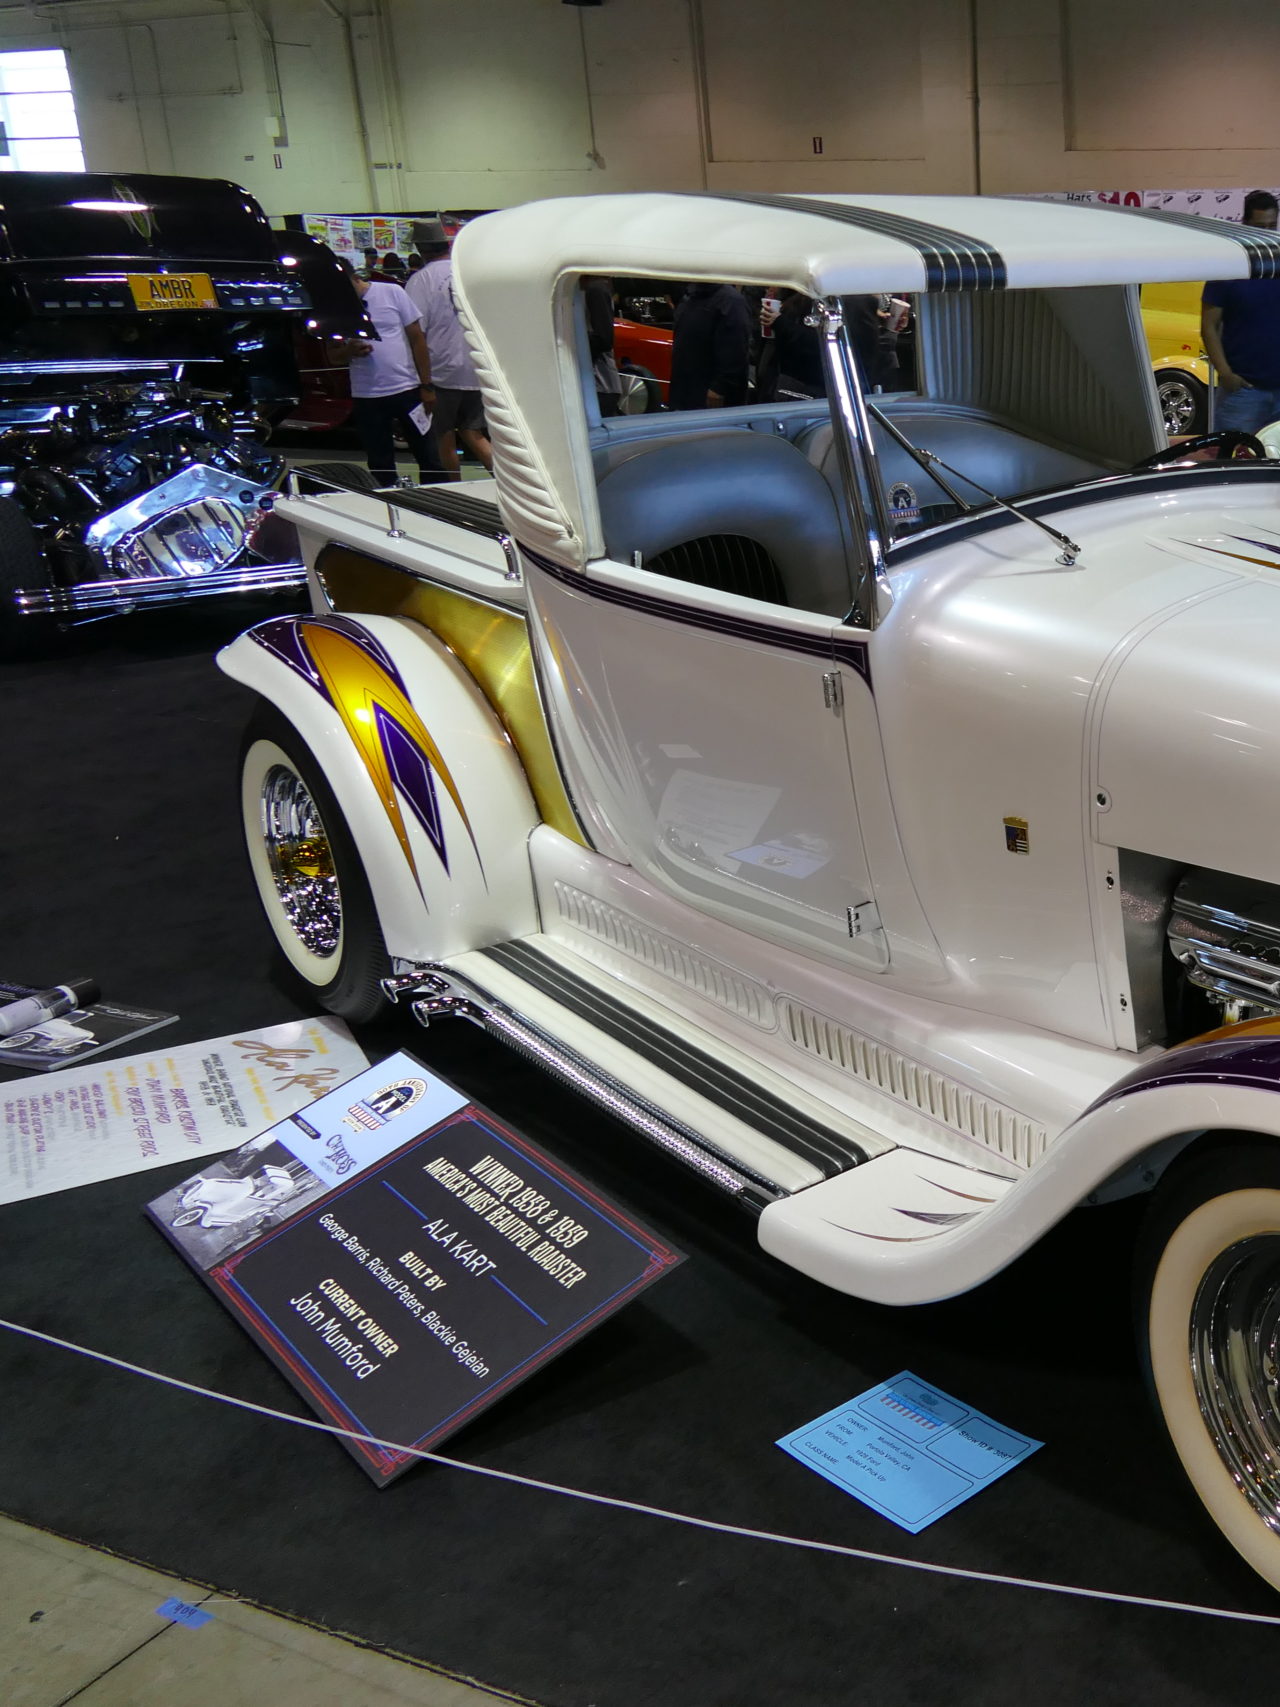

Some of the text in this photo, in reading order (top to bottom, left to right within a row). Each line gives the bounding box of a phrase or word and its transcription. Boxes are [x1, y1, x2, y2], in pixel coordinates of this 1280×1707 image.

[149, 279, 195, 299] AMBR
[155, 301, 198, 309] OREGON
[371, 1097, 397, 1115] A
[391, 1090, 407, 1103] MODEL
[468, 1154, 589, 1249] WINNER 1958 & 1959
[422, 1156, 587, 1289] AMERICA'S MOST BEAUTIFUL ROADSTER
[421, 1218, 497, 1277] ALA KART
[398, 1251, 447, 1292] BUILT BY
[319, 1213, 490, 1378] George Barris, Richard Peters, Blackie Gejeian
[290, 1291, 381, 1380] John Mumford
[318, 1278, 400, 1358] CURRENT OWNER
[957, 1431, 979, 1442] Show
[866, 1457, 881, 1465] Ford
